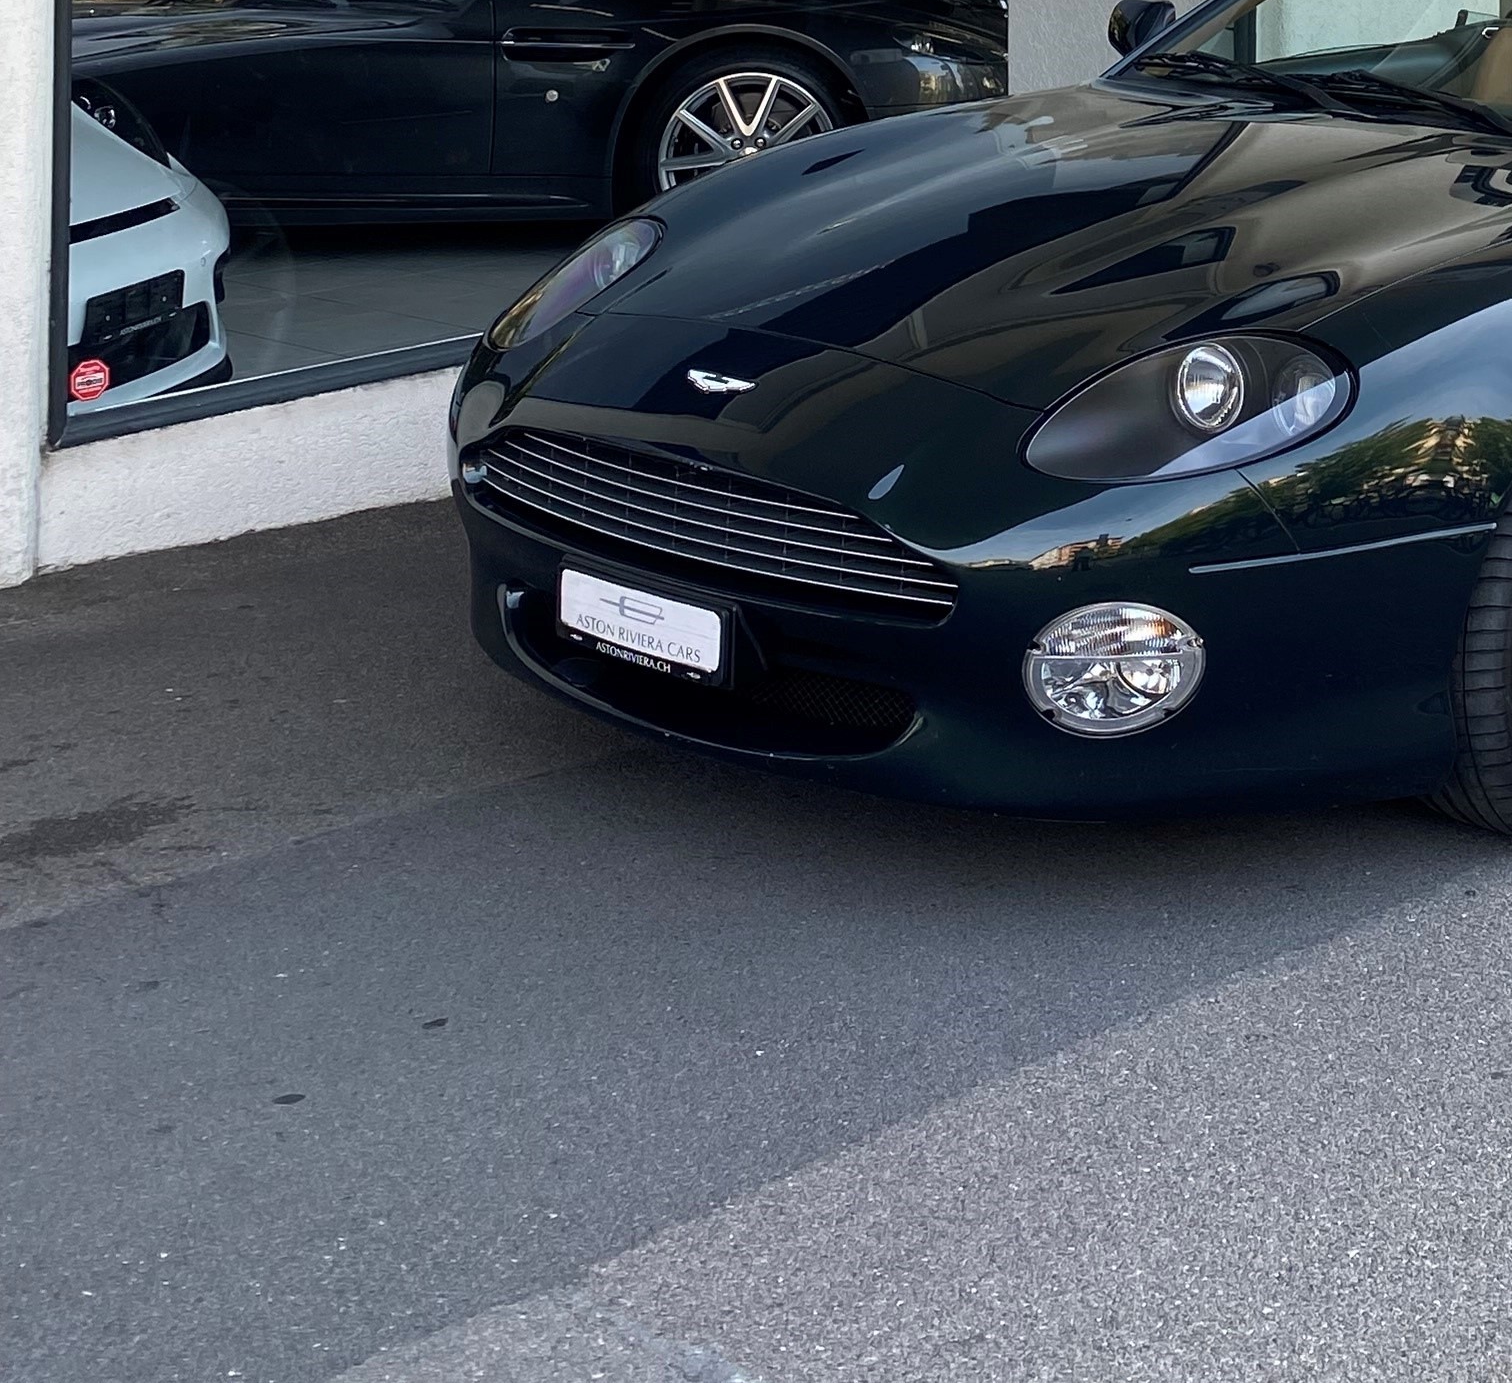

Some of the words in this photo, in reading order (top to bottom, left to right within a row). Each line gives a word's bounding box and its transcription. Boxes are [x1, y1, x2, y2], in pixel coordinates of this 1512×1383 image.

[576, 613, 615, 637] ASTON
[618, 626, 663, 654] RIVIERA
[667, 641, 701, 663] CARS
[596, 641, 671, 674] ASTONRIVIERA.CH
